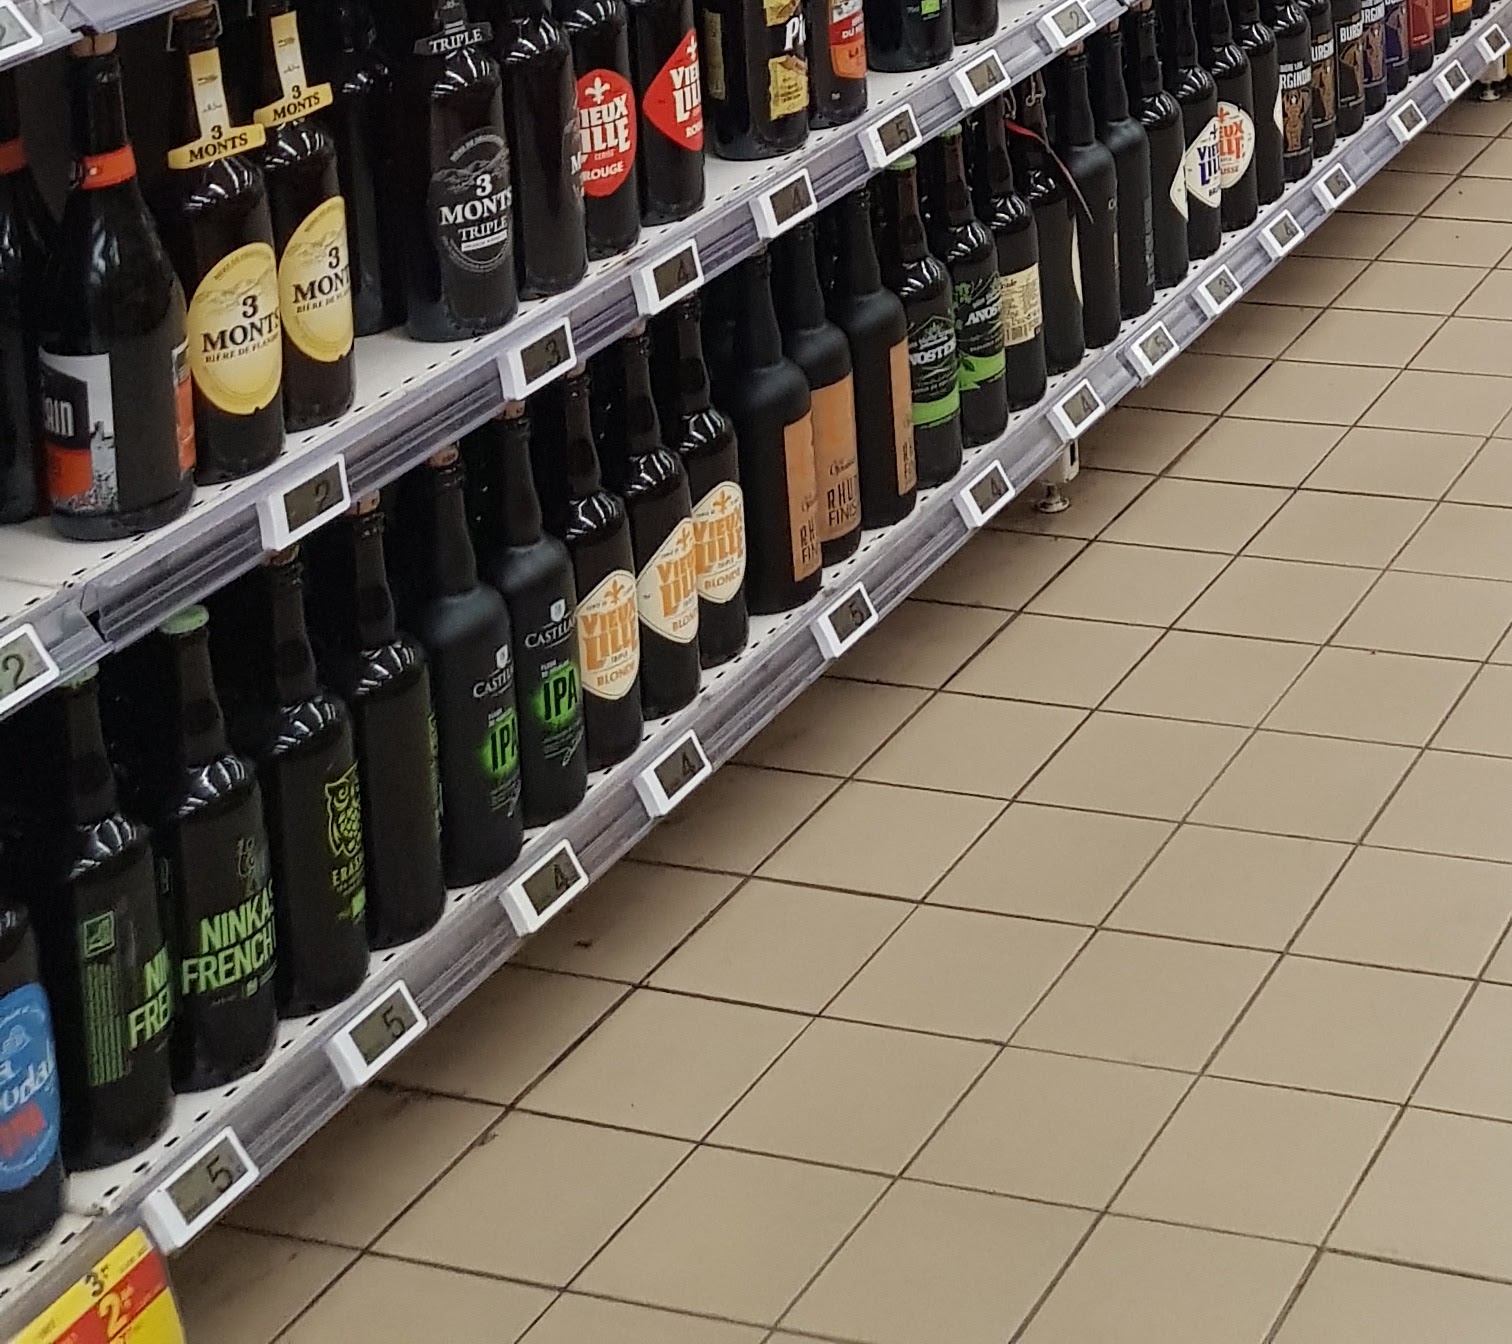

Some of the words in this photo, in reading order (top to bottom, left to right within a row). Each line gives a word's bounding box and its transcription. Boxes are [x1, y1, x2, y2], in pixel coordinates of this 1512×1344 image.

[428, 27, 483, 52] TRIPLE
[291, 84, 303, 100] 3
[272, 91, 322, 124] MONTS
[580, 93, 629, 129] IEUX
[210, 124, 223, 140] 3
[188, 132, 249, 163] MONTS
[475, 174, 492, 195] 3
[582, 161, 624, 181] ROUGE
[440, 187, 513, 226] MONTS
[458, 215, 508, 242] TRIPLE
[327, 245, 341, 270] 3
[675, 258, 691, 281] 4
[292, 265, 350, 304] MONT
[241, 294, 260, 319] 3
[201, 311, 281, 353] MONTS
[546, 338, 560, 363] 3
[313, 479, 331, 510] 2
[828, 501, 858, 526] FINIS
[704, 567, 741, 589] BLONDE
[1, 653, 25, 691] 2
[596, 664, 635, 686] BLONDE
[543, 674, 577, 719] IPA
[489, 720, 519, 772] IPA
[681, 753, 695, 775] 4
[553, 863, 567, 890] 4
[200, 889, 275, 953] NINKA
[182, 932, 273, 995] FRENCH
[382, 1006, 406, 1039] 5
[205, 1155, 233, 1193] 5
